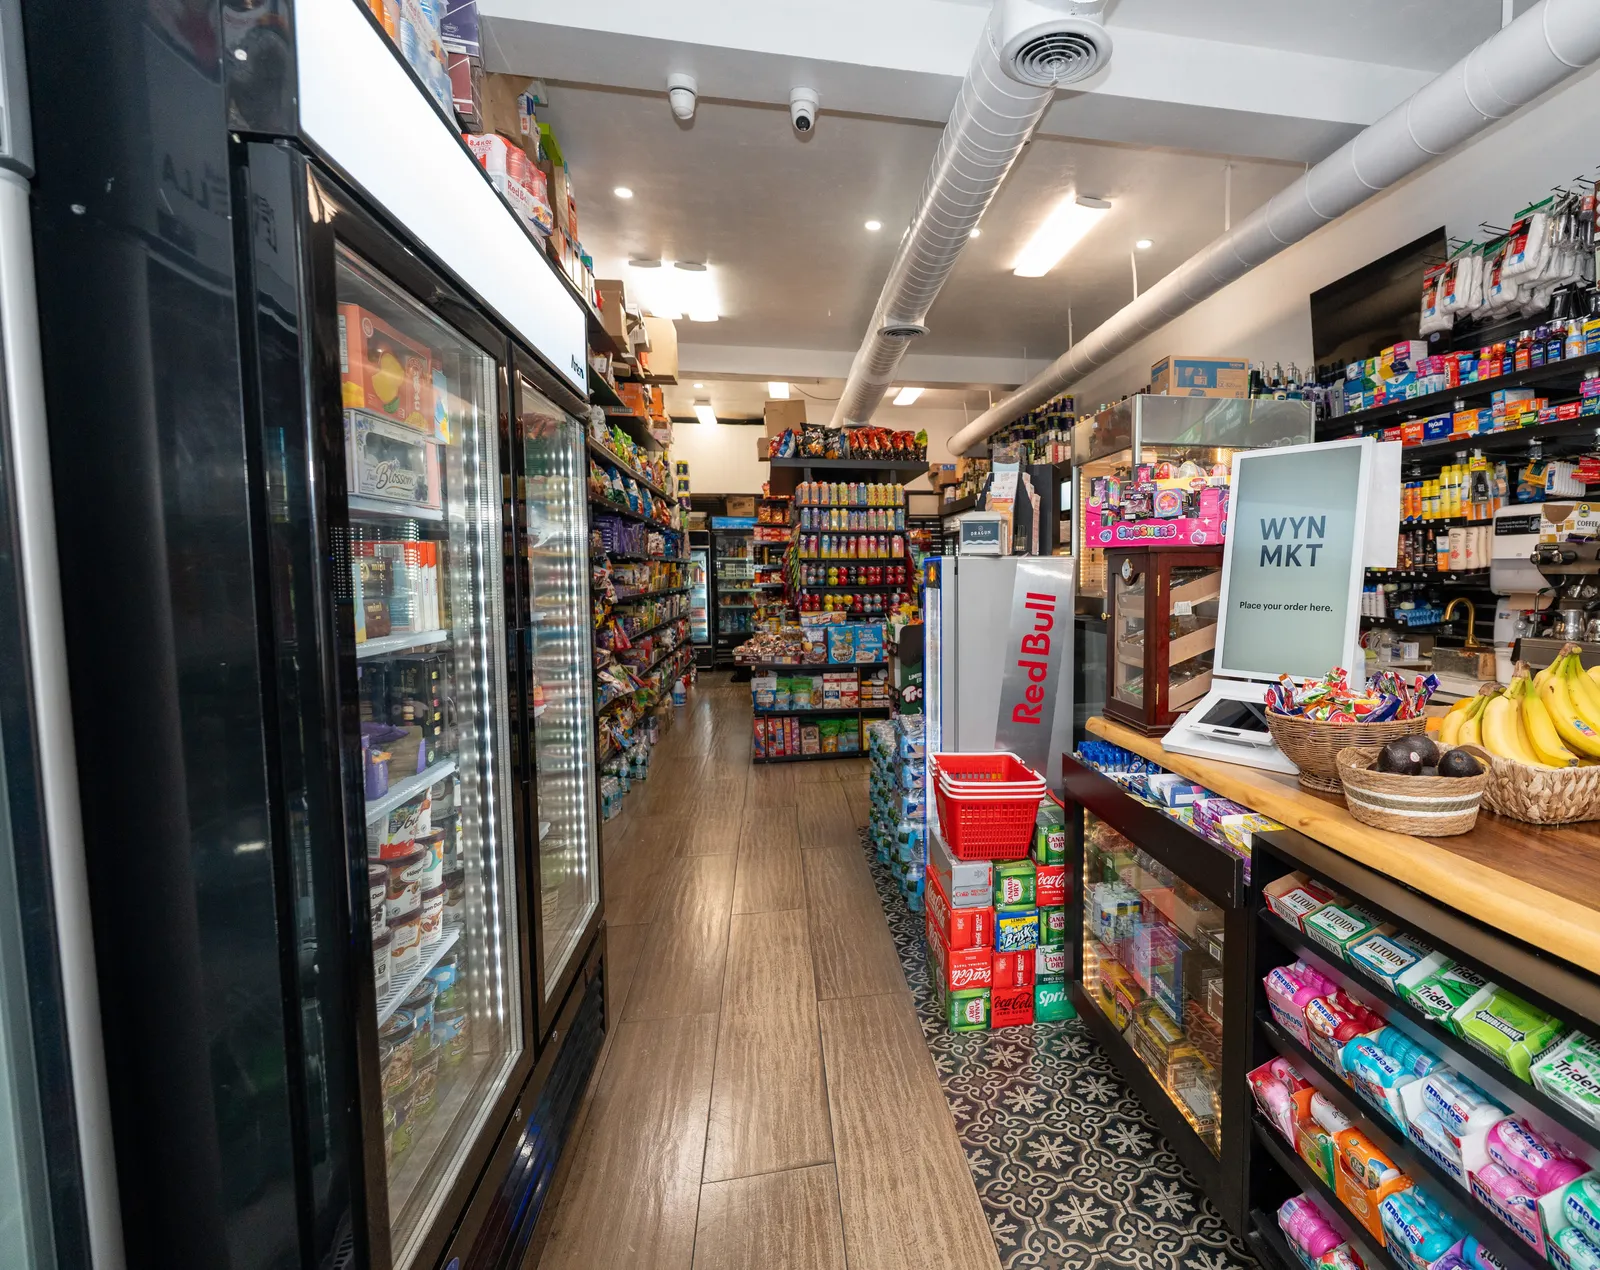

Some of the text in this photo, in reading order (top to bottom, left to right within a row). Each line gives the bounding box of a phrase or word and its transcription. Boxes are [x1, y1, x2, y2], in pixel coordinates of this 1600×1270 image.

[507, 180, 520, 197] Red
[1428, 420, 1443, 428] NyQuil
[375, 460, 415, 490] Blossom
[1260, 515, 1326, 540] WYN
[1260, 544, 1323, 567] MKT
[1239, 601, 1333, 612] Place your order here.
[1011, 592, 1056, 725] Red Bull
[1041, 827, 1048, 835] 12
[1287, 893, 1317, 911] ALTOID
[1320, 910, 1359, 933] ALTOIDS
[1366, 941, 1407, 967] ALTOIDS
[952, 966, 991, 987] Coca-Cola
[1272, 970, 1296, 995] mentos
[1449, 964, 1487, 987] Triden
[994, 992, 1032, 1010] Coca-Cola
[1039, 988, 1067, 1007] Spri
[1312, 999, 1338, 1028] mentos
[1477, 1011, 1524, 1041] DOUBLEMINT
[1364, 1045, 1395, 1075] mentos
[1553, 1071, 1587, 1096] WHITE
[1555, 1060, 1600, 1097] Triden
[1426, 1084, 1463, 1123] mentos
[1409, 1126, 1462, 1177] mentos
[1508, 1121, 1551, 1160] mentos
[1385, 1200, 1418, 1245] mentos
[1472, 1182, 1537, 1244] mentos
[1567, 1195, 1600, 1231] men
